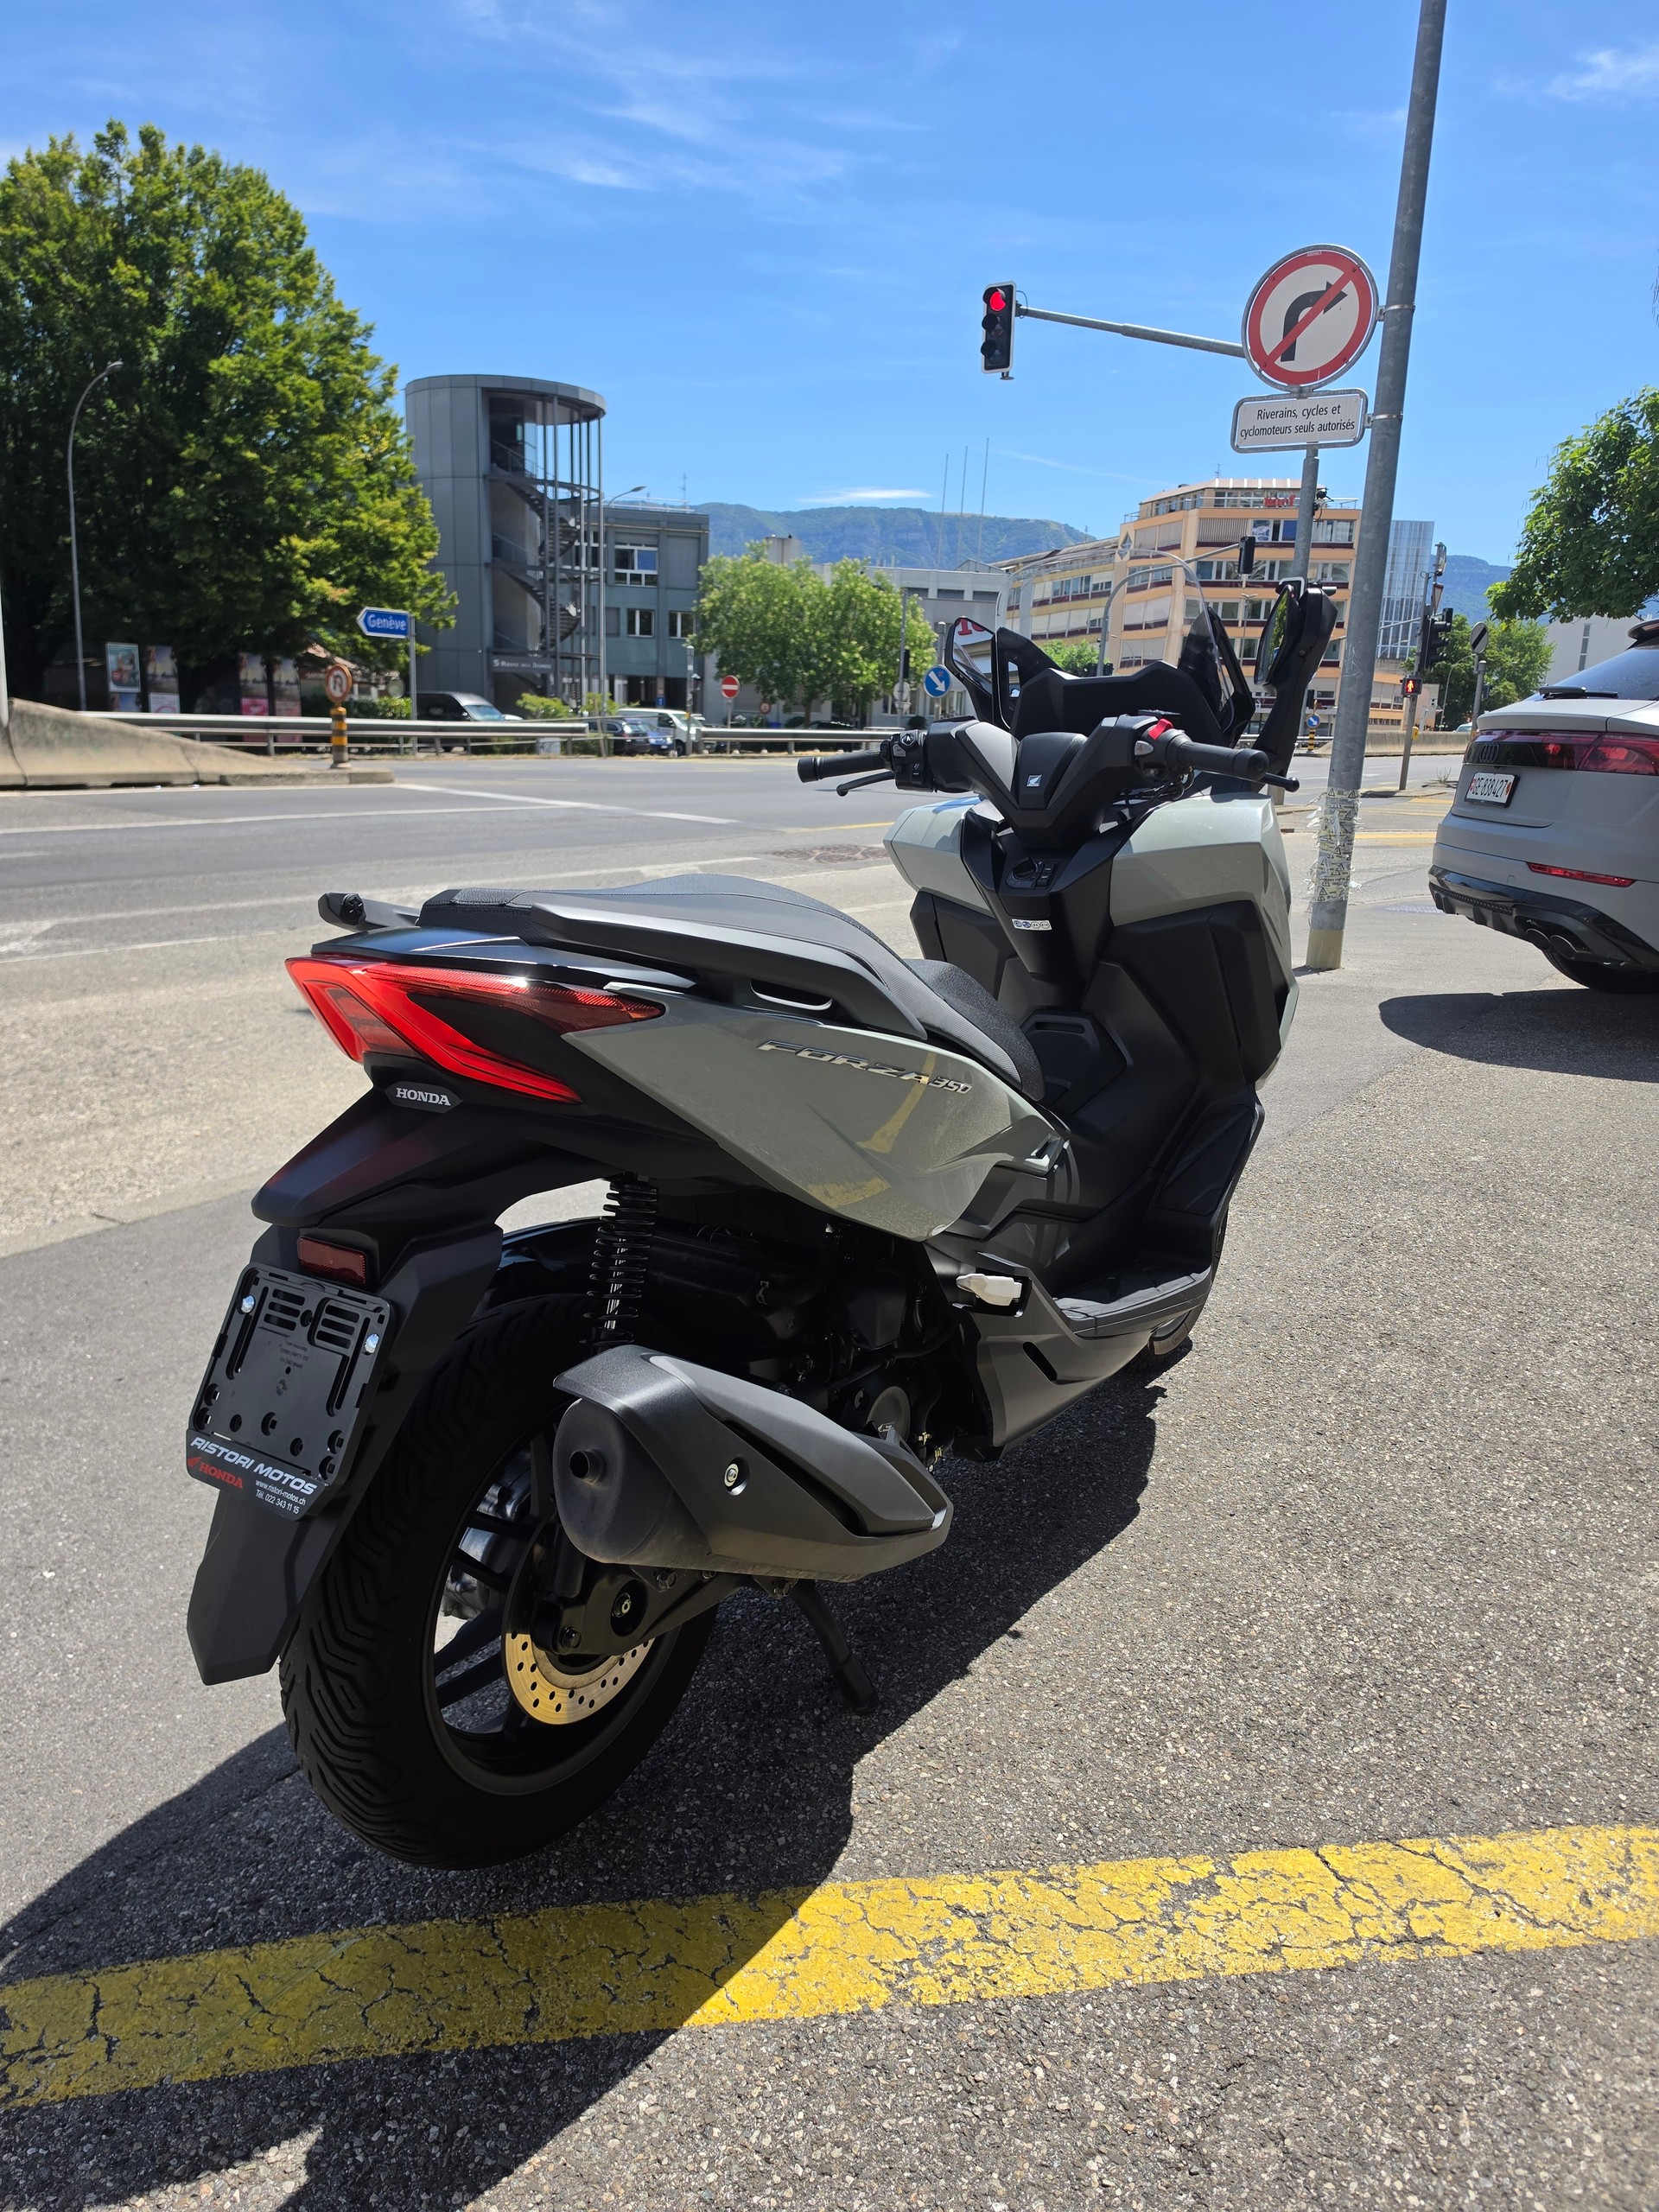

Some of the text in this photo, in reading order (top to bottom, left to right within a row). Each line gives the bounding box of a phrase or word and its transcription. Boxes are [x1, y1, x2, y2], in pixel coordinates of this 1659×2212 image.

[1256, 404, 1341, 421] Riverains, cycles et
[1240, 420, 1355, 440] cyclomoteurs seuls autorisés
[367, 613, 407, 631] Genève
[756, 1039, 973, 1095] FORZA 350
[396, 1087, 451, 1106] HONDA
[190, 1436, 318, 1496] RISTORI MOTOS
[199, 1462, 244, 1489] HONDA
[256, 1479, 307, 1505] www.ristori-motos.ch
[256, 1490, 301, 1515] Tél. 022 343 11 15
